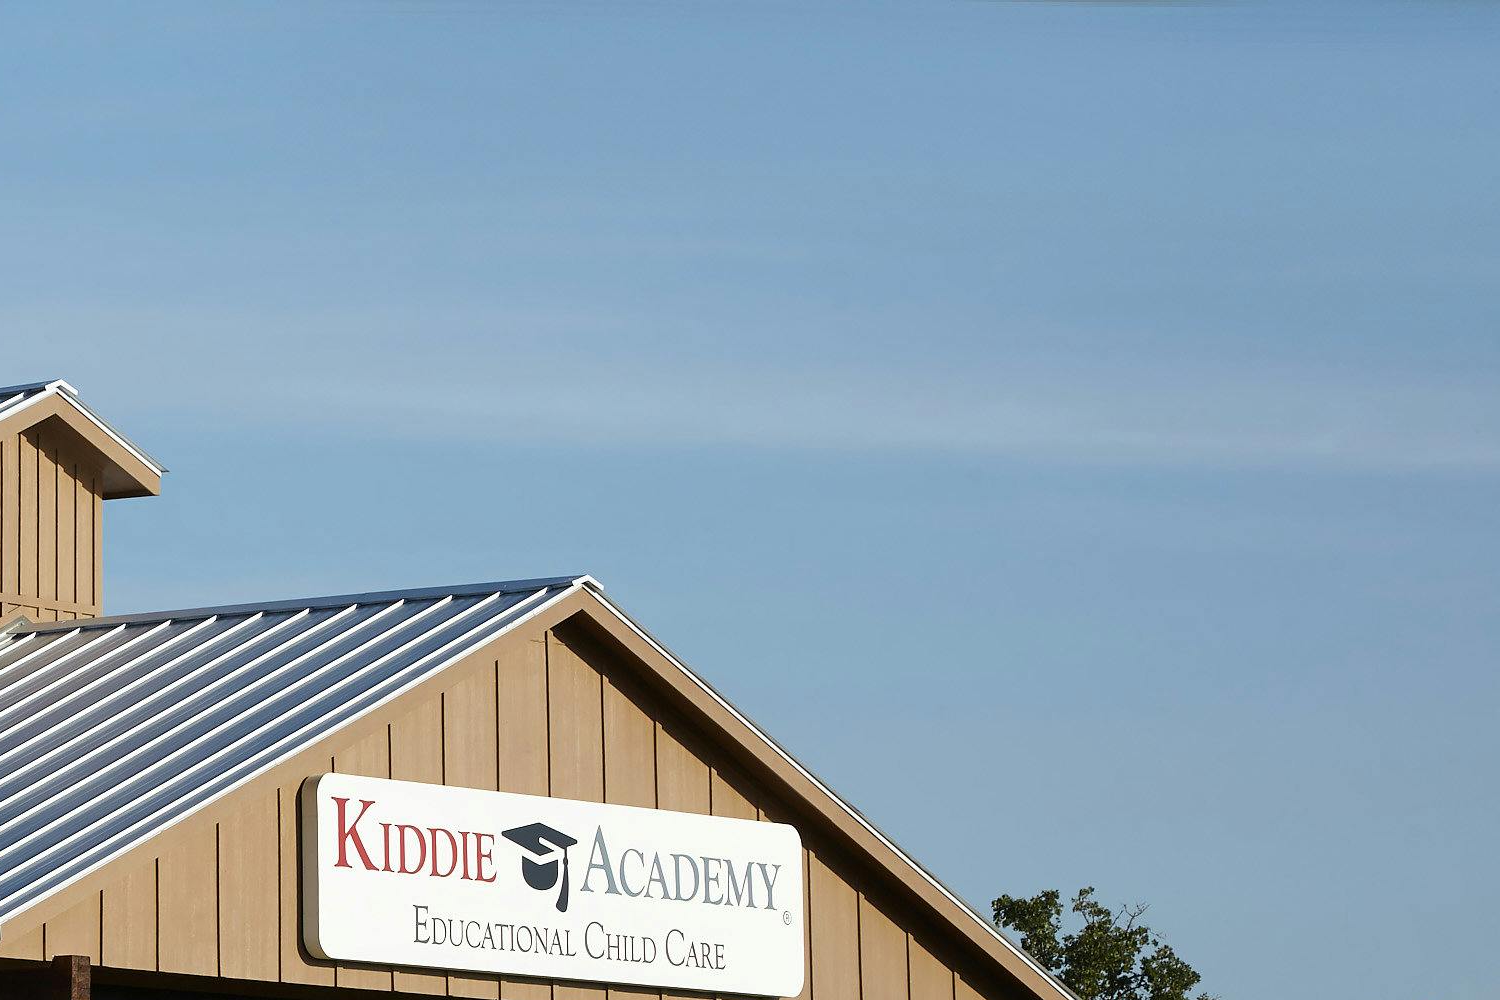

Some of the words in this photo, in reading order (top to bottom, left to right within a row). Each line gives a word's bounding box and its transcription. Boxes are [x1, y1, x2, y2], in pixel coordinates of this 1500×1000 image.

[331, 796, 498, 883] KIDDIE
[413, 904, 577, 957] EDUCATIONAL
[584, 921, 657, 964] CHILD
[665, 929, 726, 970] CARE
